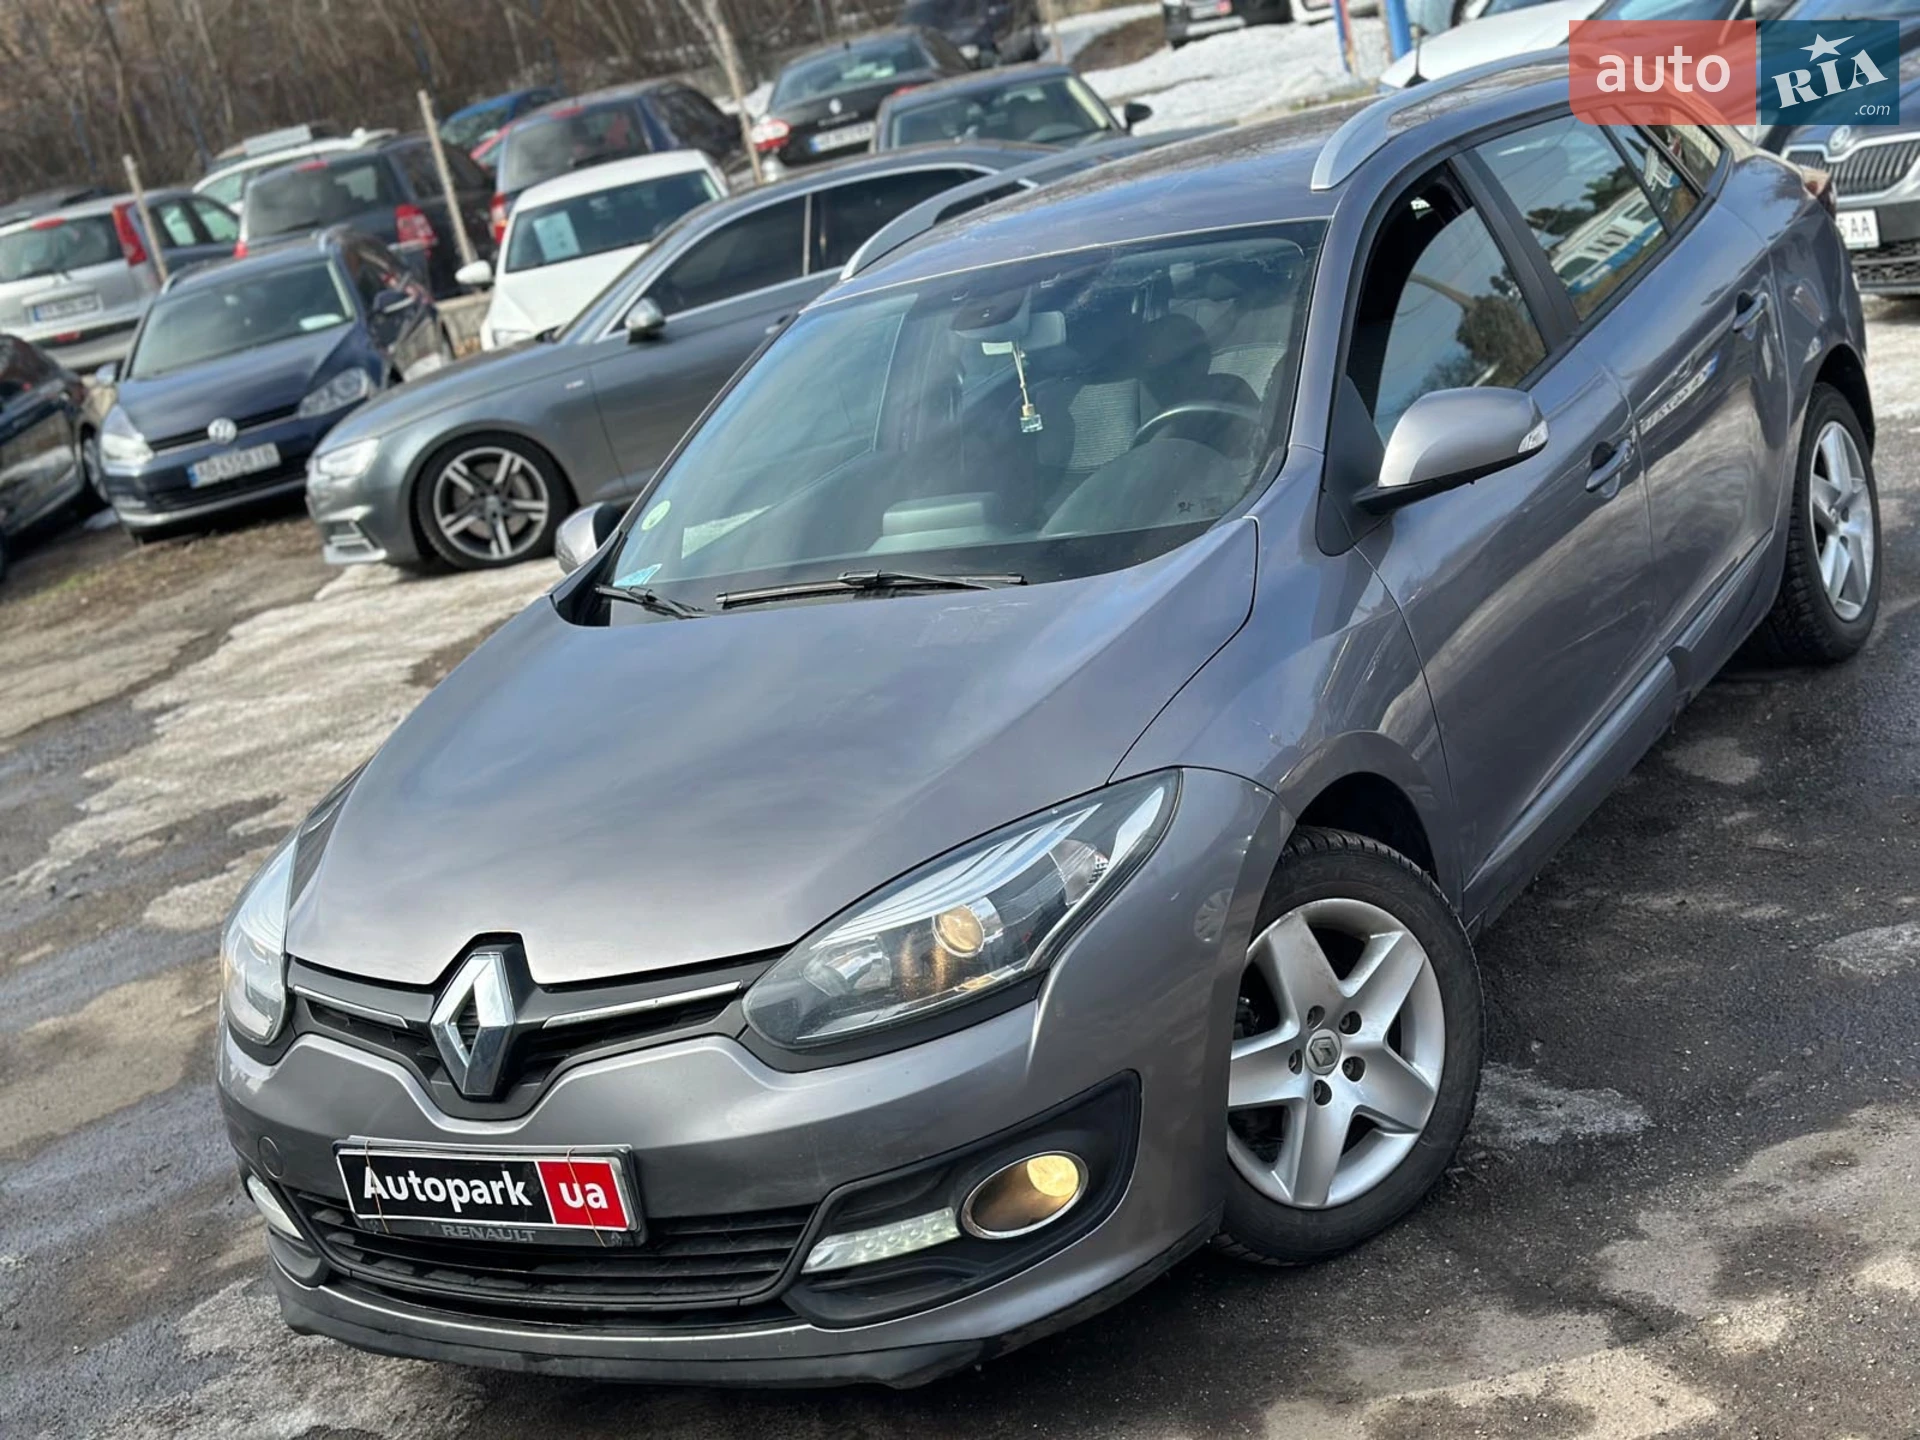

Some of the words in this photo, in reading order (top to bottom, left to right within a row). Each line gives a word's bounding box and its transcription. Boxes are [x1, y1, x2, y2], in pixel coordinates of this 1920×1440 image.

[363, 1165, 533, 1213] Autopark
[558, 1180, 609, 1210] ua
[440, 1224, 536, 1243] RENAULT
